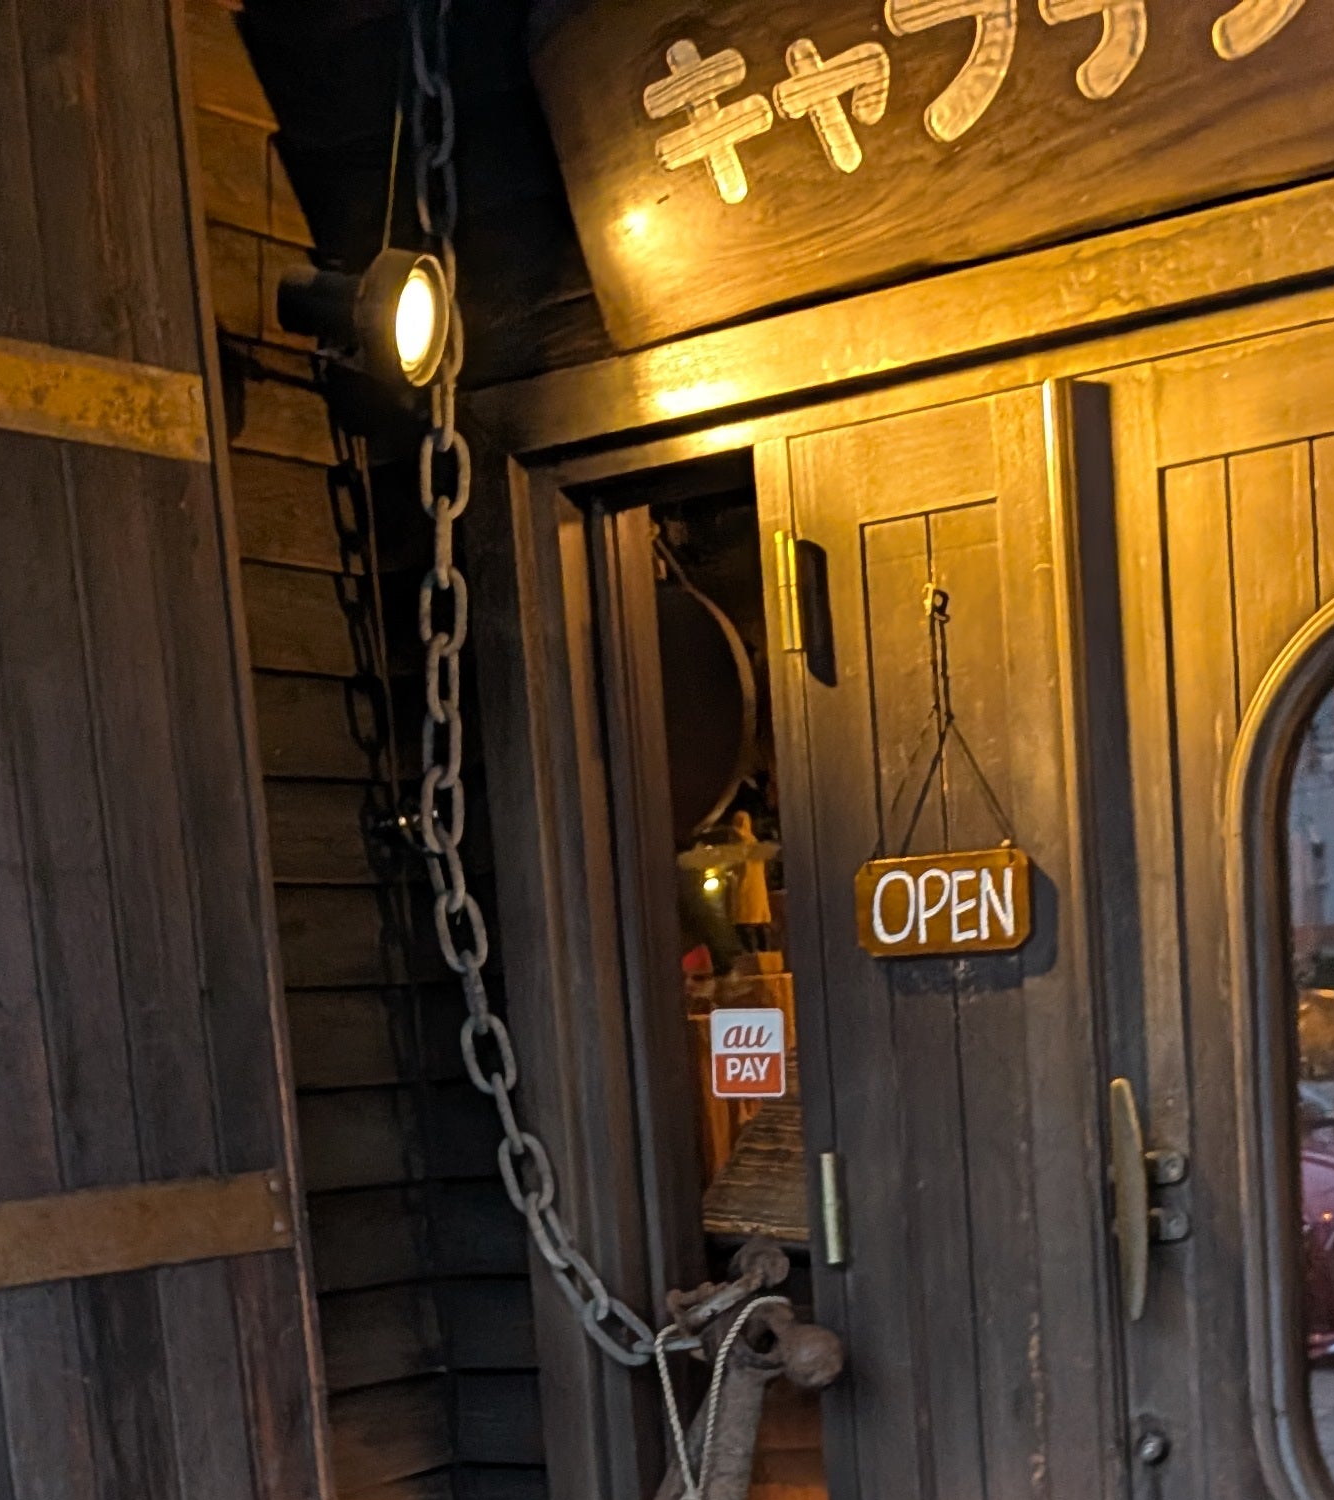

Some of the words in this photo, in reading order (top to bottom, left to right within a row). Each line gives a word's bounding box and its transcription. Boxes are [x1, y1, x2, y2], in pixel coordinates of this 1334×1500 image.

[871, 866, 1015, 945] OPEN
[722, 1023, 775, 1050] au
[725, 1056, 772, 1084] PAY
